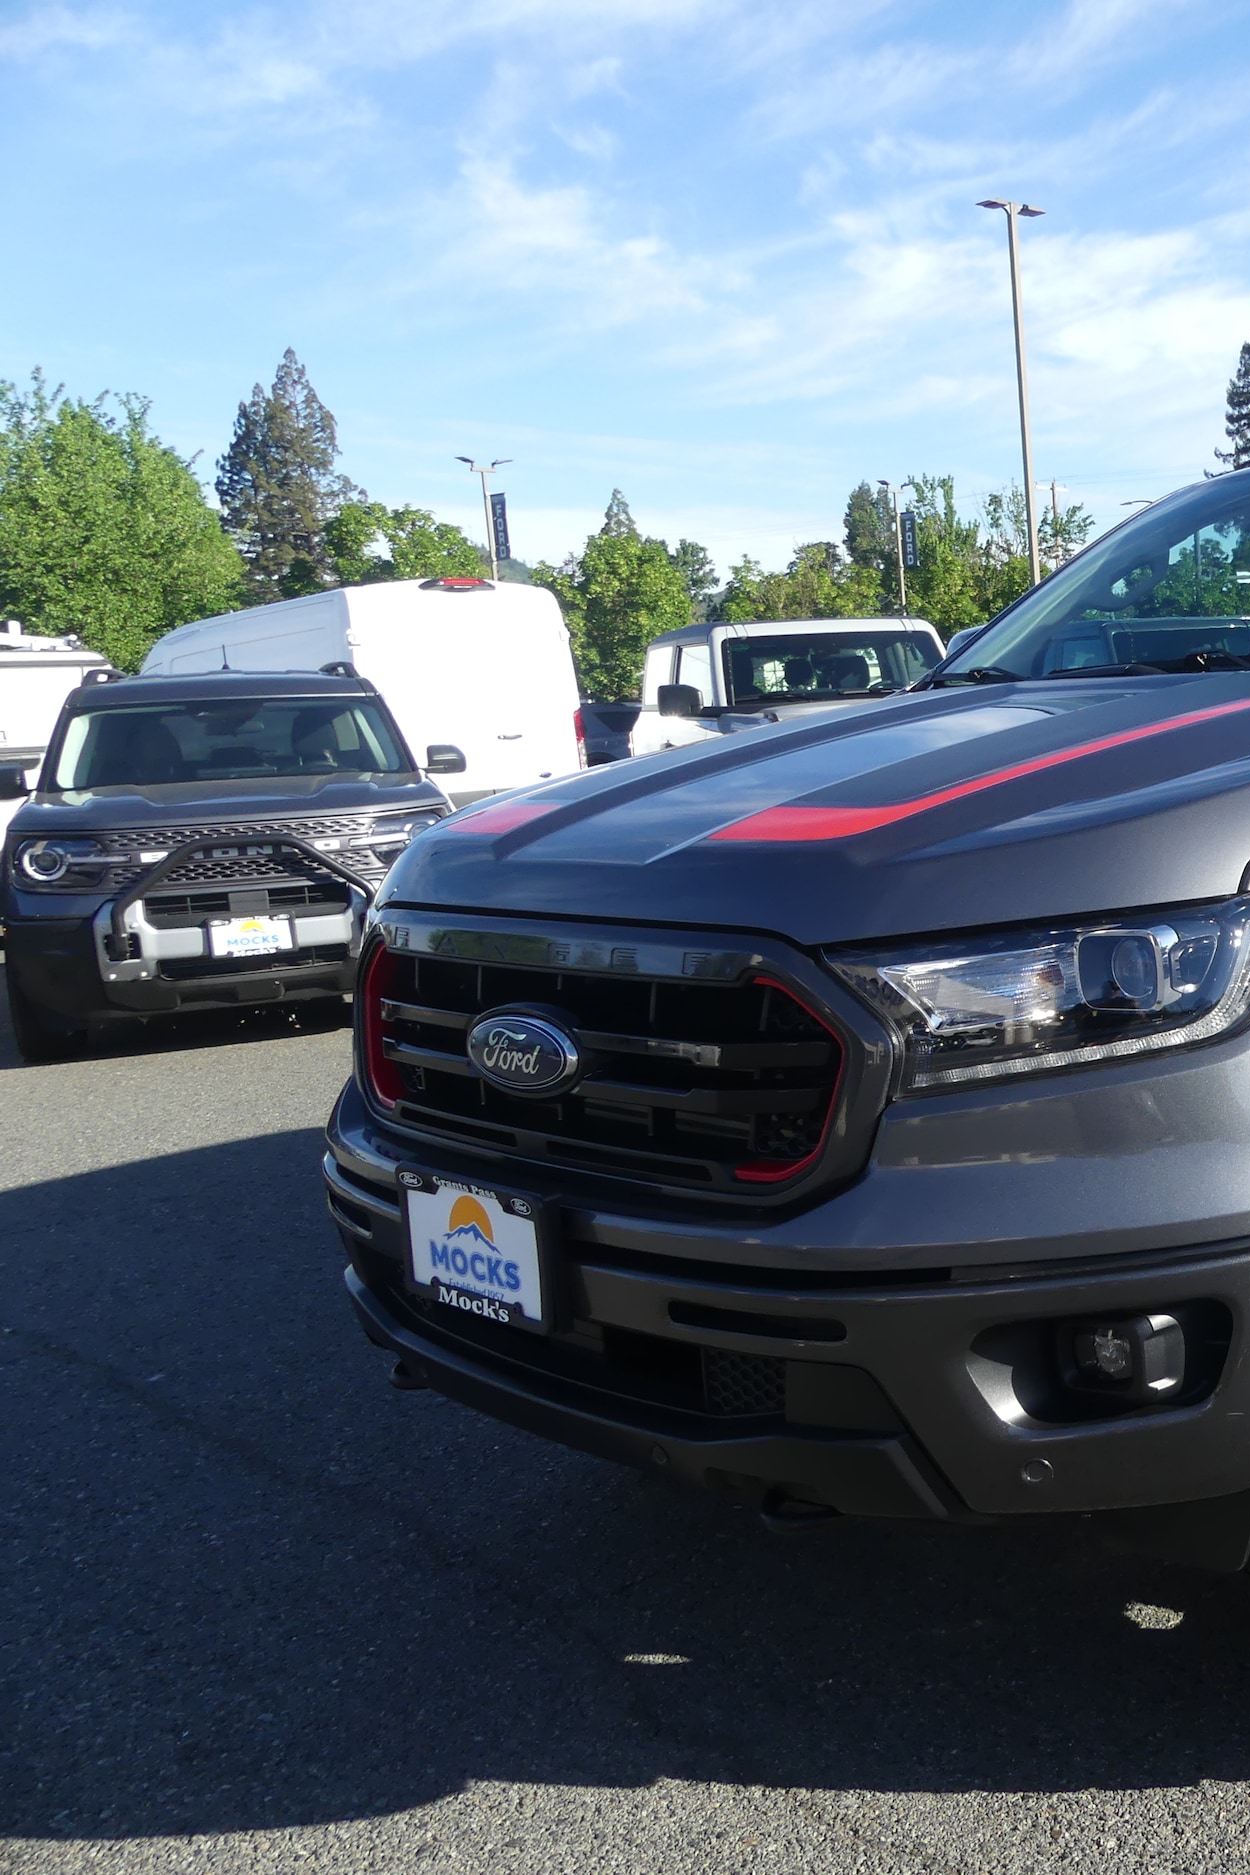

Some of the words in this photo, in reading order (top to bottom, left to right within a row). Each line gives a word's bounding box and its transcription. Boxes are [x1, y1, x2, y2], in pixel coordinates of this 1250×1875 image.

[495, 505, 507, 558] FORD
[905, 521, 915, 566] FORD
[227, 935, 279, 946] MOCKS
[484, 1027, 541, 1074] Ford
[432, 1175, 469, 1193] Grants
[470, 1184, 498, 1199] Pass
[430, 1239, 521, 1292] MOCKS
[439, 1286, 510, 1323] Mock's
